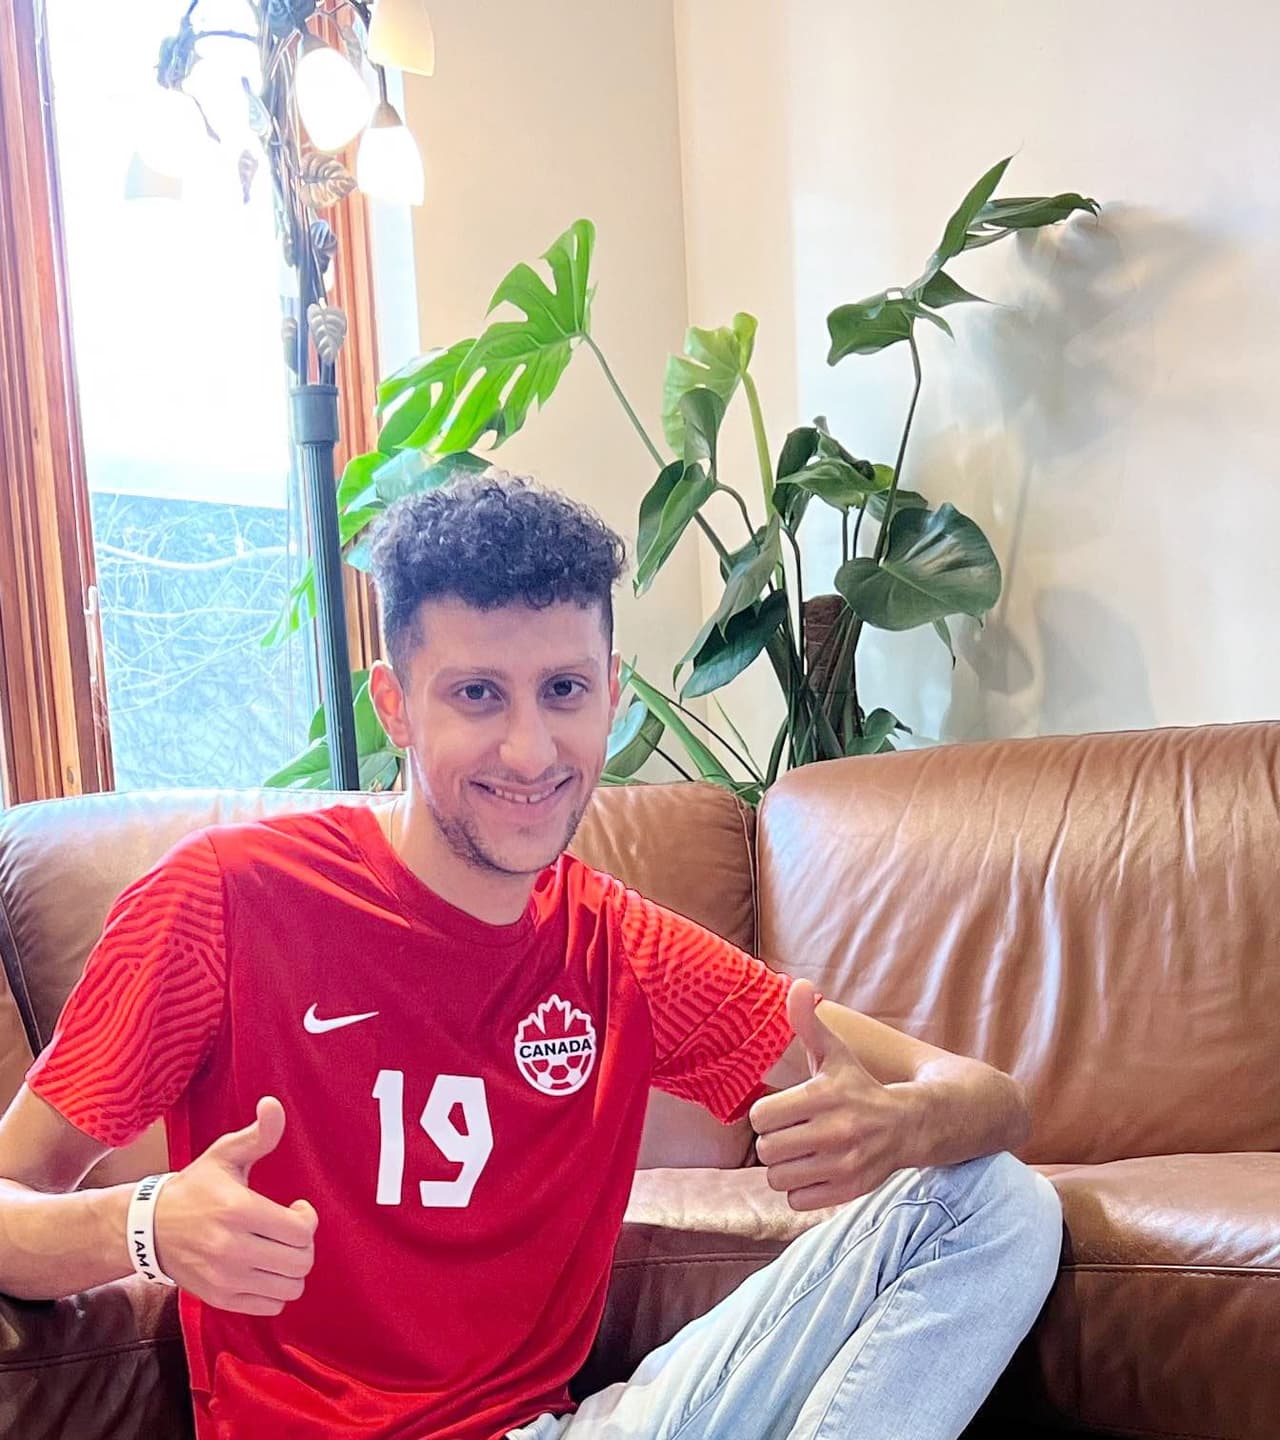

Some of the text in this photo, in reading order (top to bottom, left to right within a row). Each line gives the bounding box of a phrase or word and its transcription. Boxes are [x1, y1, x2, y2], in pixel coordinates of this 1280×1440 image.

[519, 1038, 593, 1059] CANADA
[371, 1068, 494, 1209] 19
[134, 1240, 151, 1268] AM
